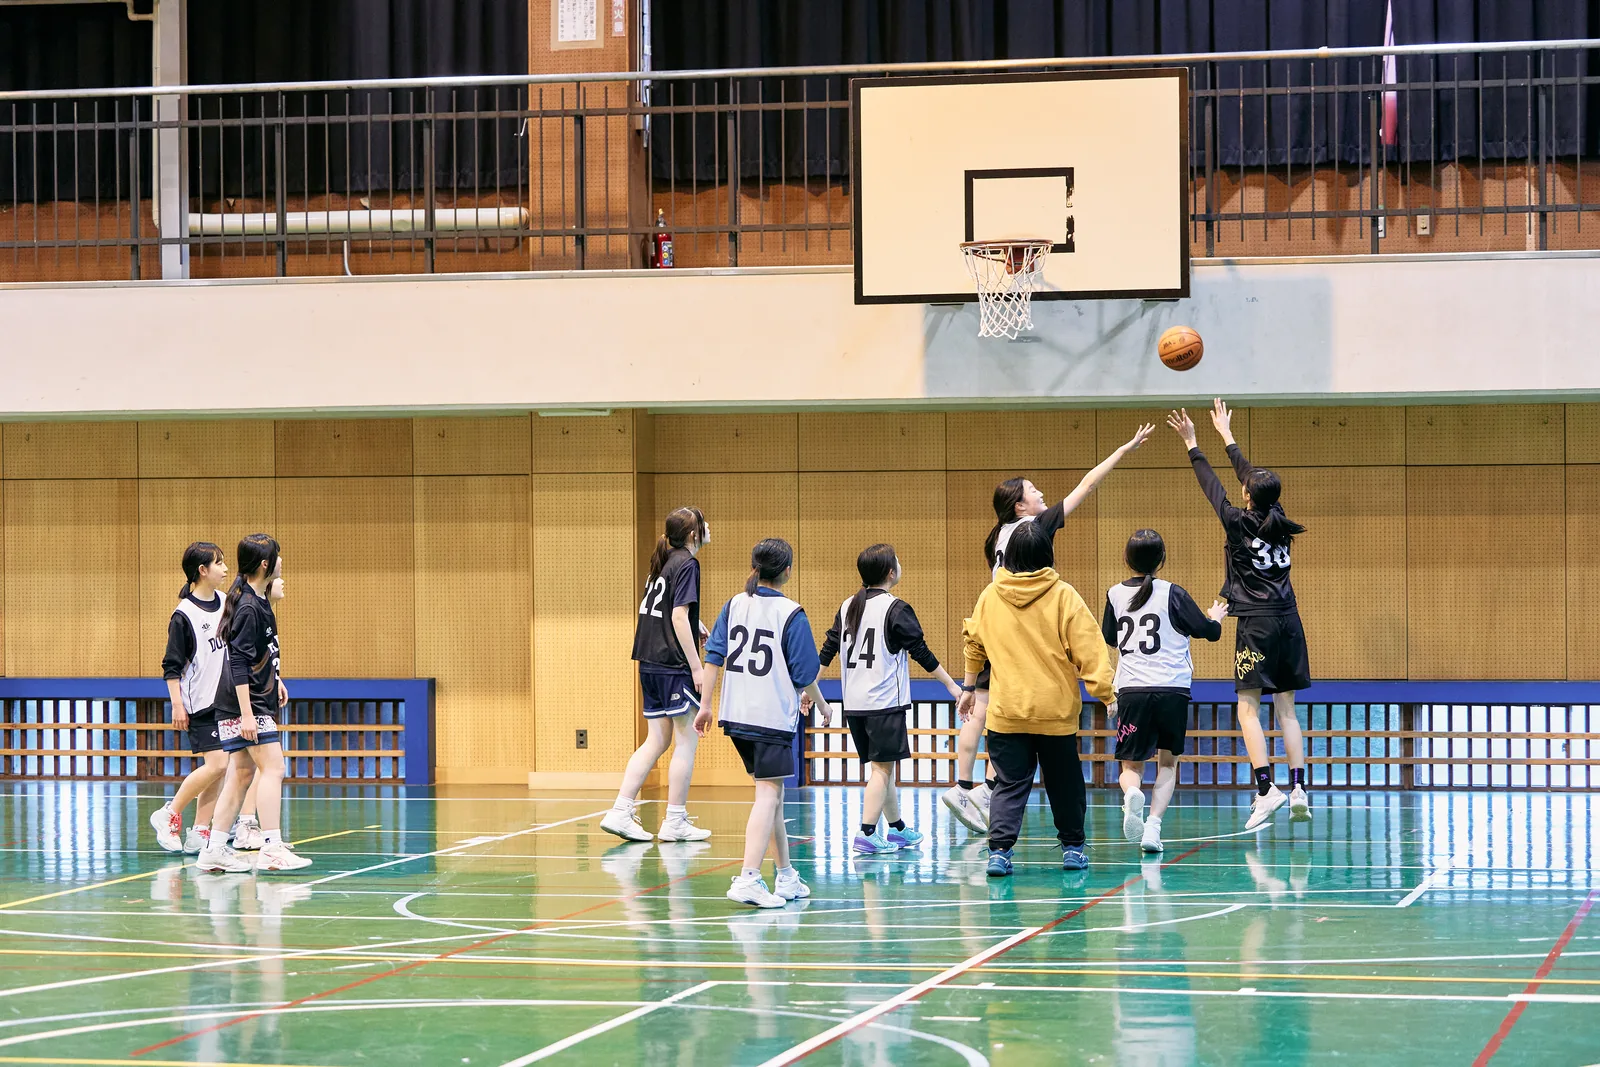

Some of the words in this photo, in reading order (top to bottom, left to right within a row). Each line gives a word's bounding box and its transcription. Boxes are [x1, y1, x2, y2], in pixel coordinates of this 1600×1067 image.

[1166, 349, 1194, 364] molten
[639, 574, 666, 618] 22
[726, 625, 774, 677] 25
[843, 627, 876, 669] 24
[1116, 613, 1161, 656] 23
